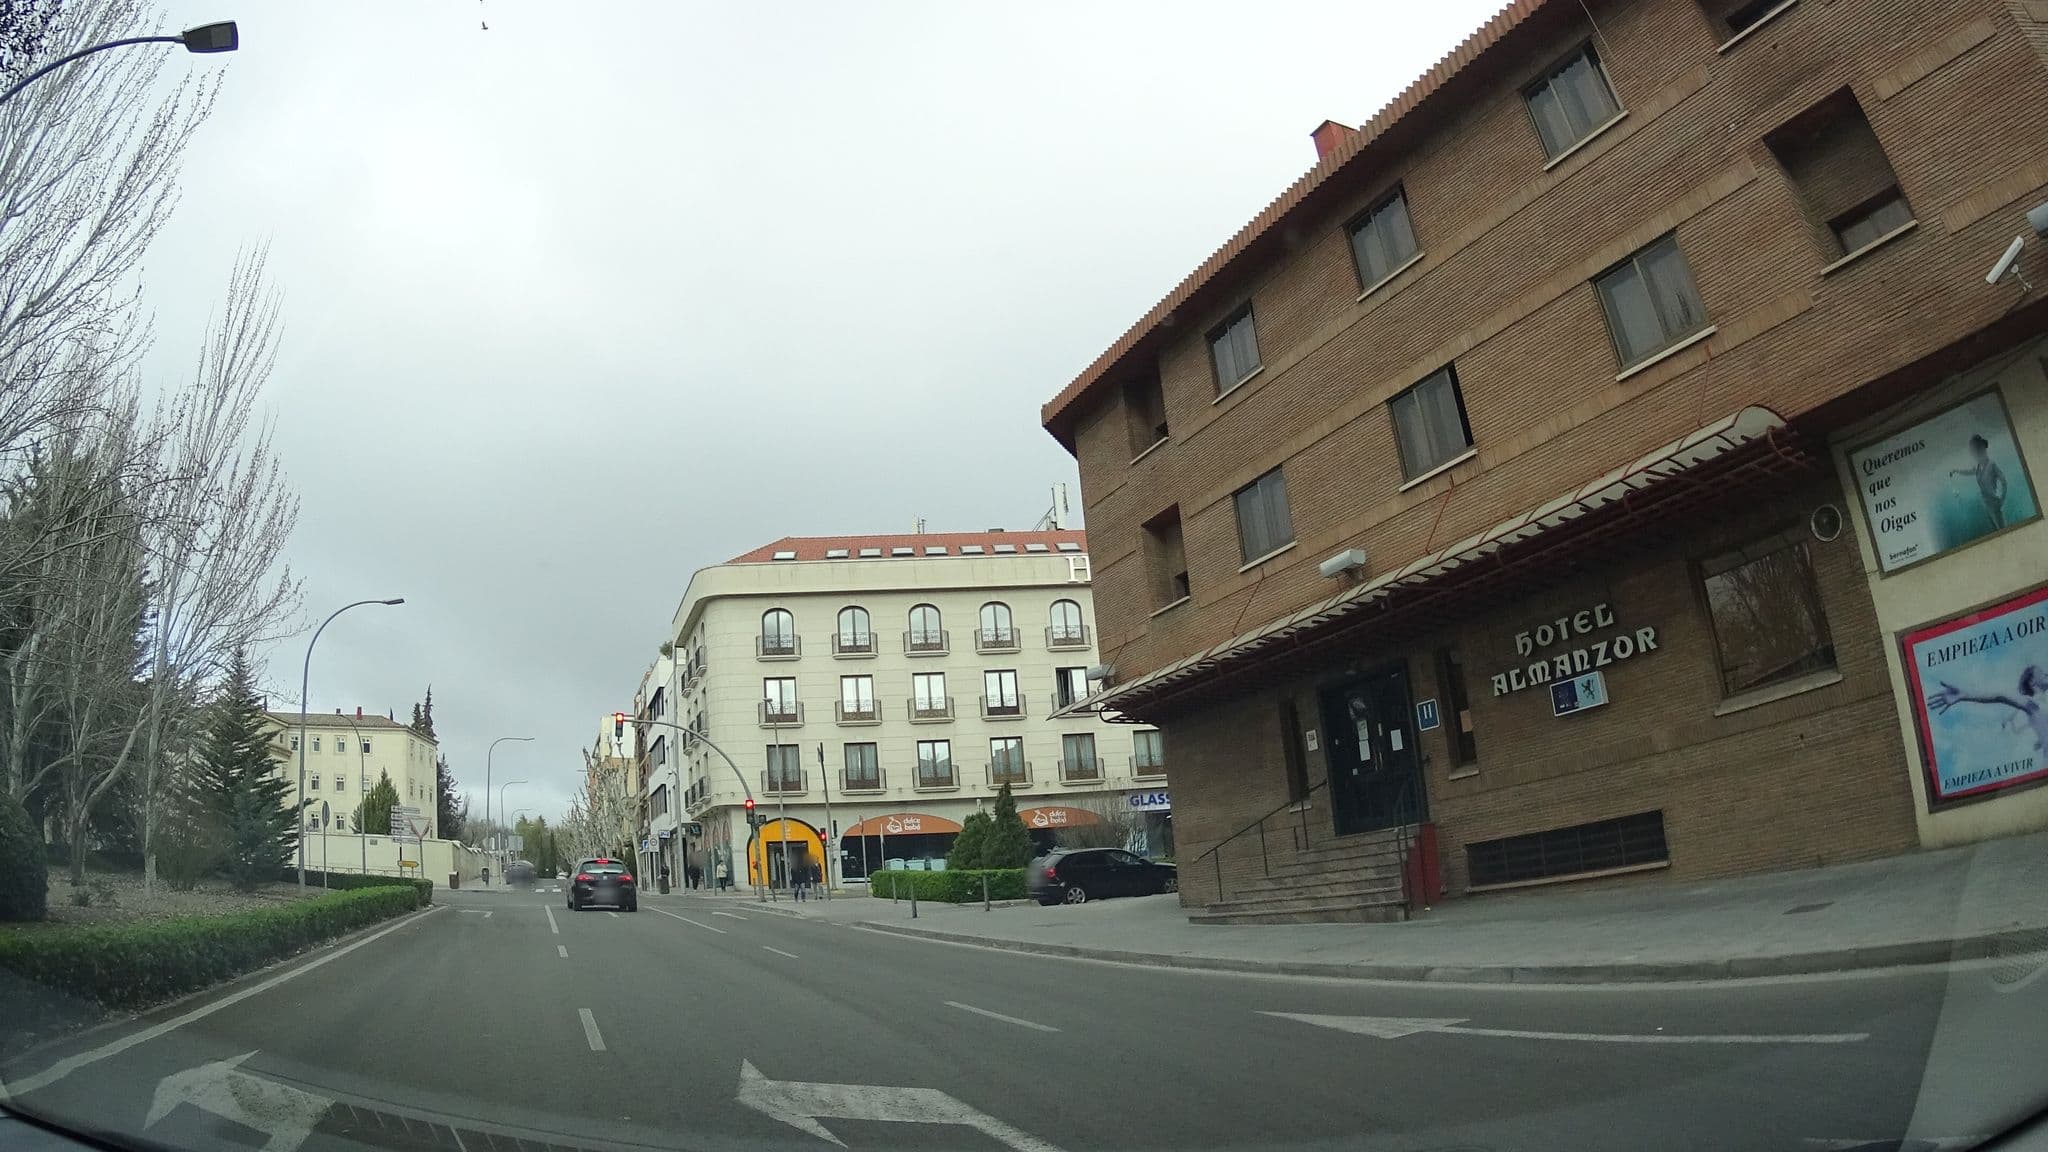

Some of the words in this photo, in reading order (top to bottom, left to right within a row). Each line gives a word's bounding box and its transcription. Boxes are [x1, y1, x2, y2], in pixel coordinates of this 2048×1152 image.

[1862, 439, 1926, 477] Queremos
[1869, 475, 1892, 496] que
[1874, 496, 1897, 514] nos
[1880, 511, 1917, 534] Oigas
[1927, 632, 2002, 668] EMPIEZA
[2003, 627, 2016, 644] A
[2017, 615, 2047, 638] OIR
[1490, 627, 1658, 697] ALMANZOR
[1944, 768, 1993, 790] EMPIEZA
[1993, 765, 2003, 777] A
[2003, 758, 2034, 774] VIVIR
